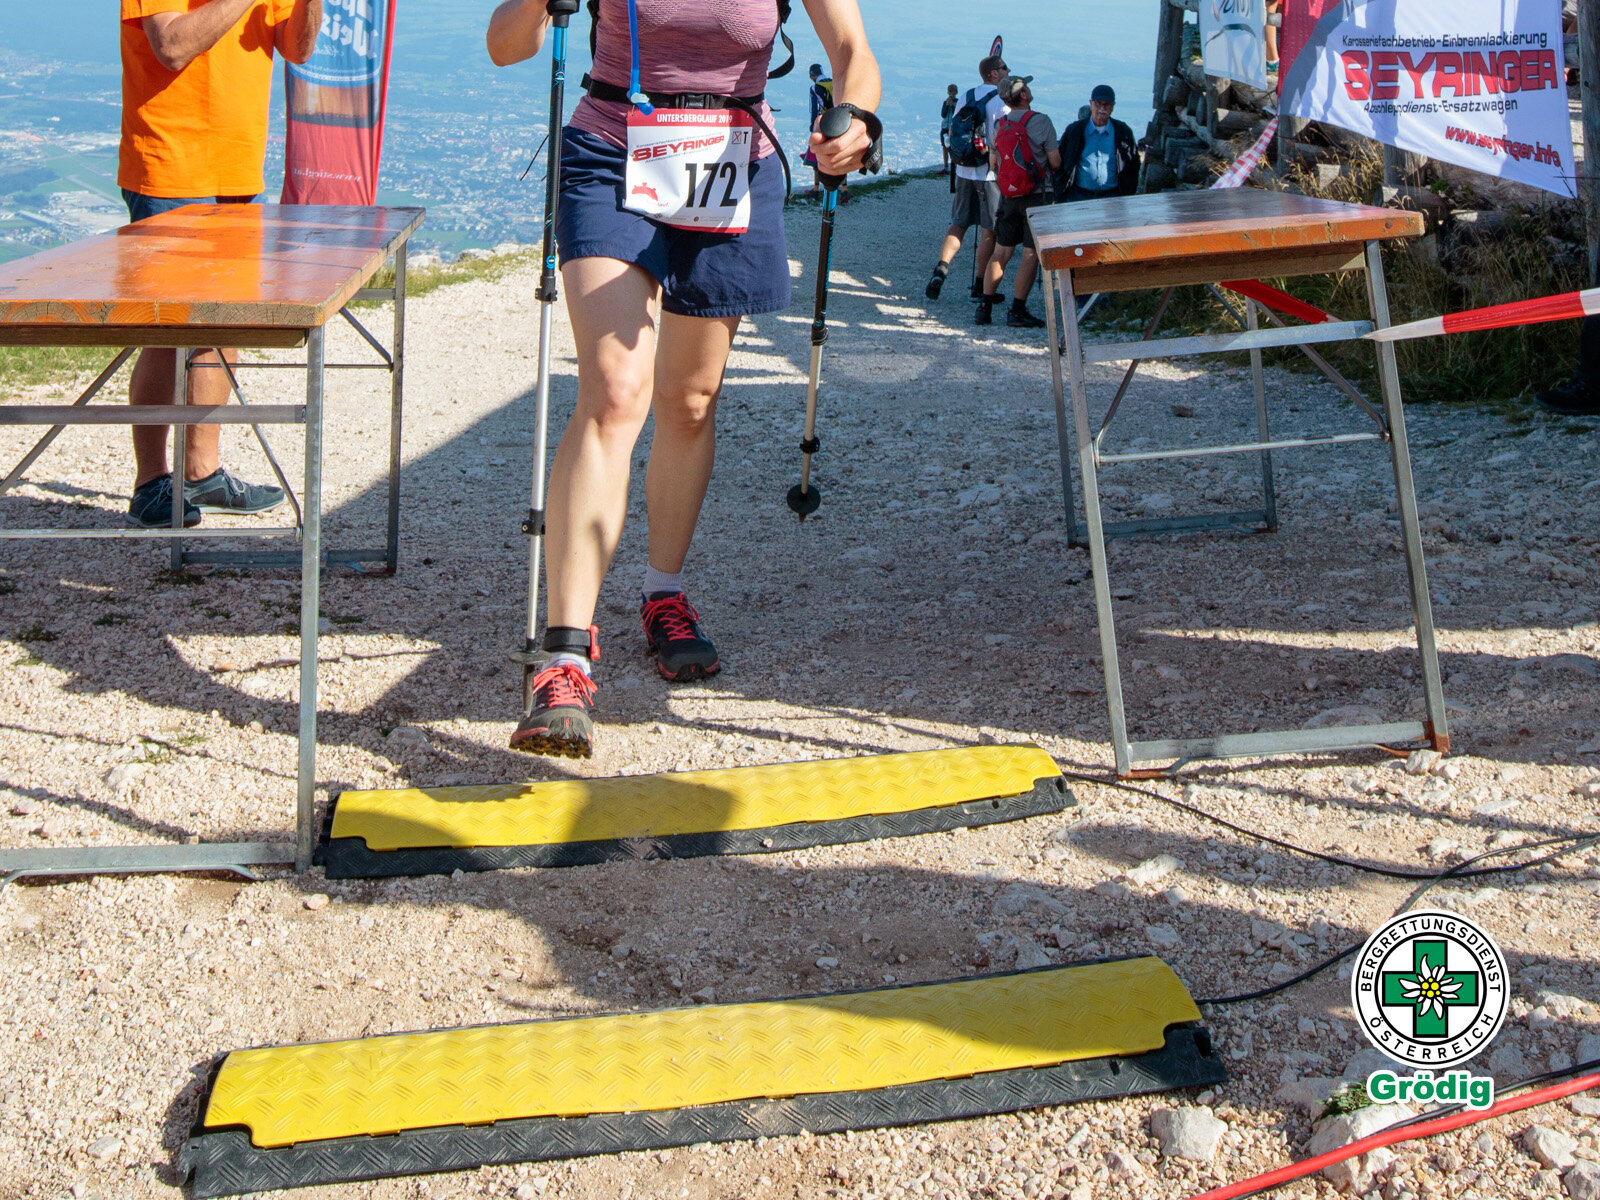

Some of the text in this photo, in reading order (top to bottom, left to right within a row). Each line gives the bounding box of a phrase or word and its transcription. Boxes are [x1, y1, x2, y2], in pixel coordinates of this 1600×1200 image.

[1340, 49, 1558, 101] SEYRINGER
[656, 113, 733, 124] UNTERSBERGLAUF 2019
[685, 161, 738, 209] 172
